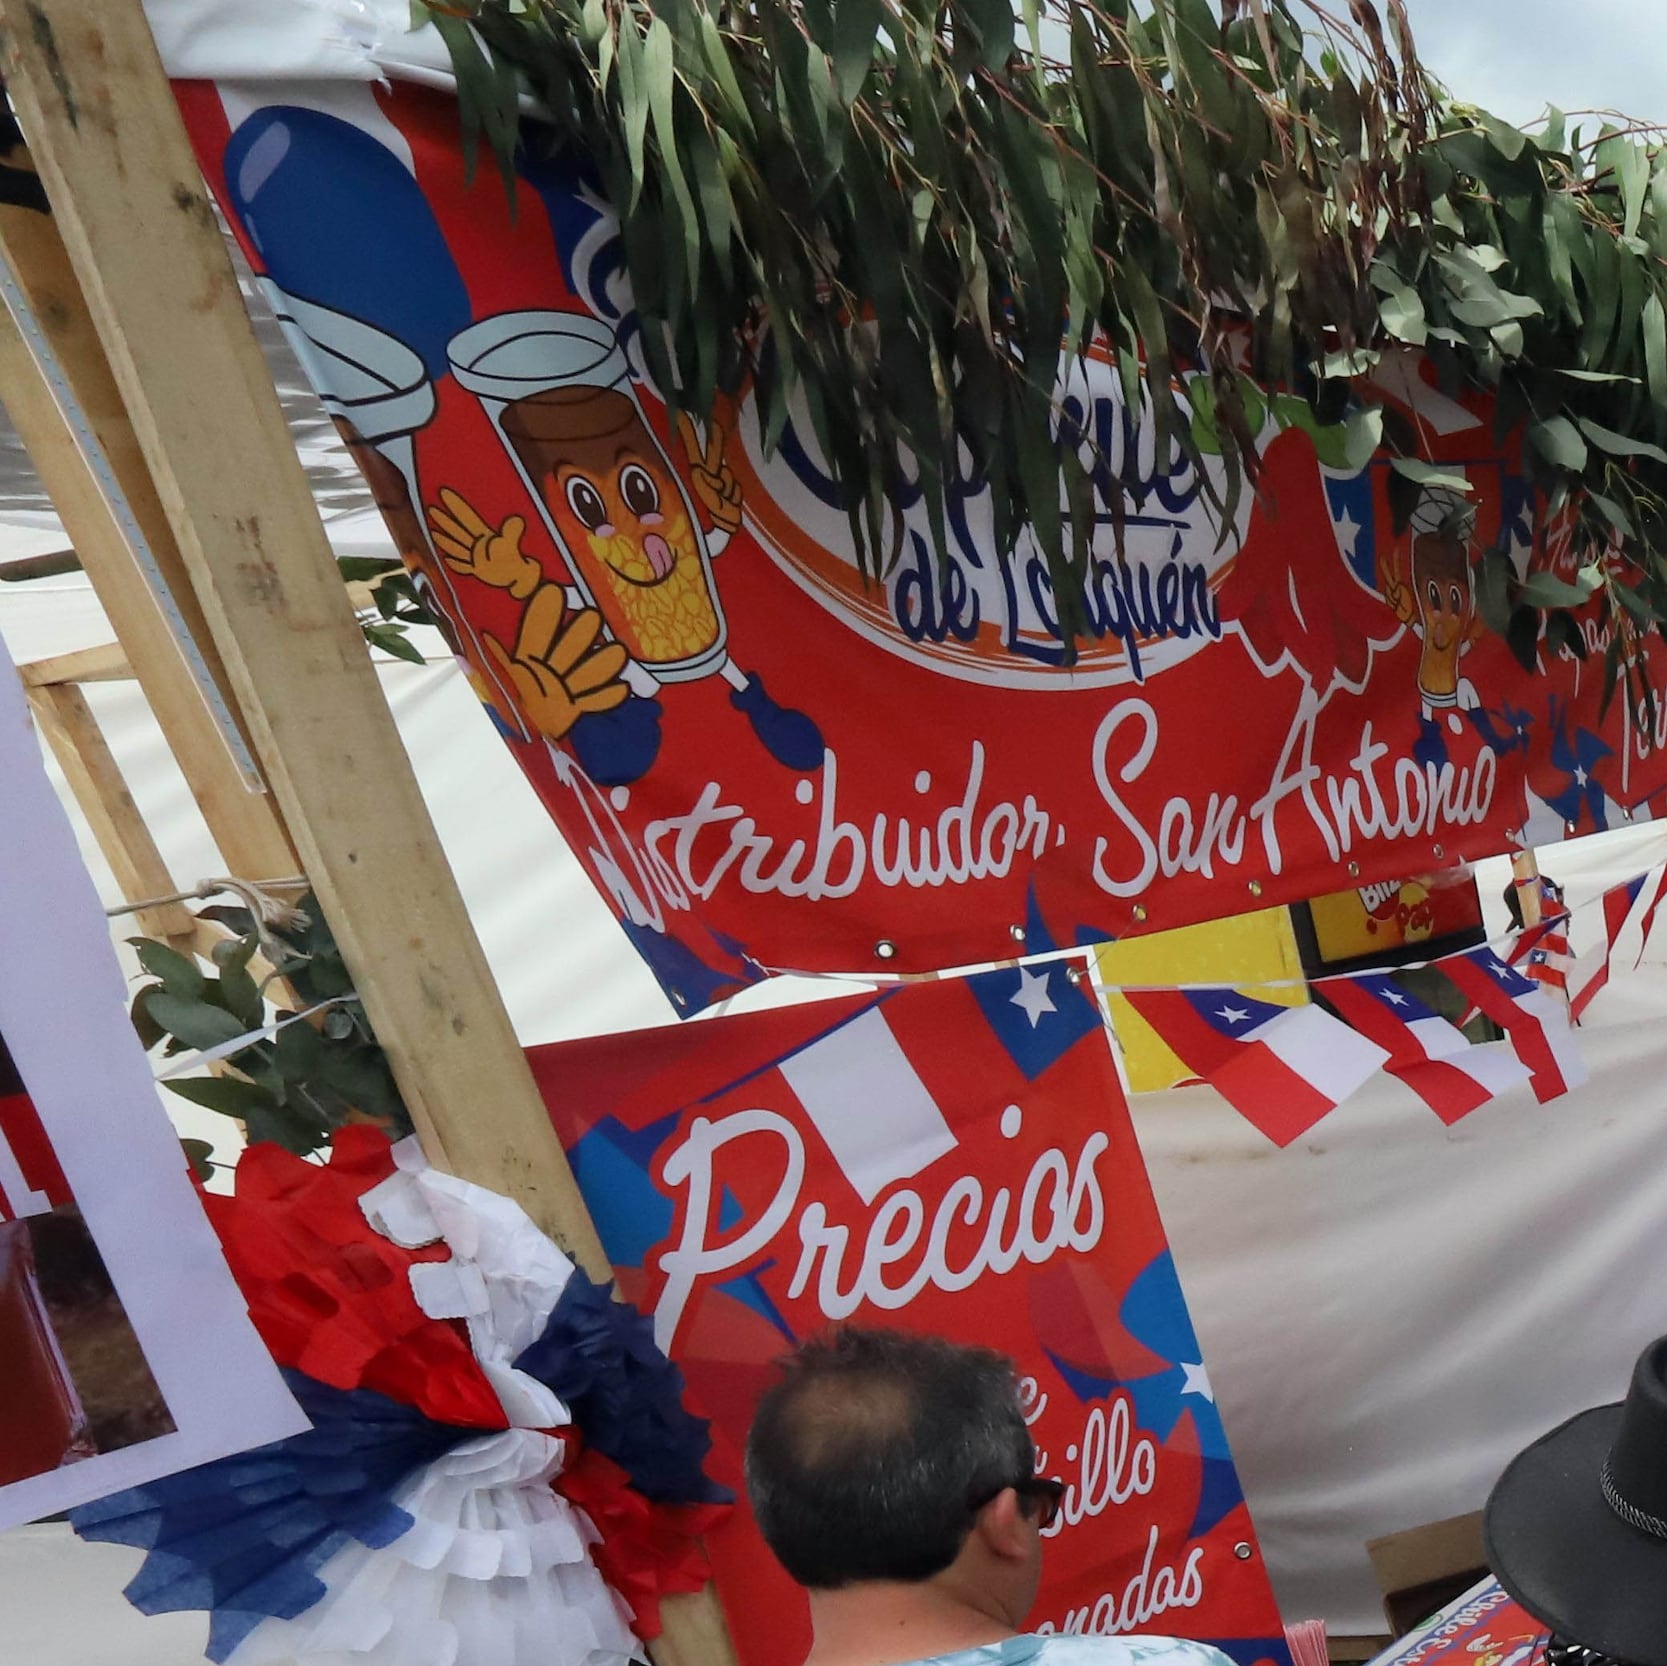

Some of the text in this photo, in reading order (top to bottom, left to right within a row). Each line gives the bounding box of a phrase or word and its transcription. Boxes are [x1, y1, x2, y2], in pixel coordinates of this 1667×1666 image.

[895, 528, 1223, 682] de Loquén
[543, 688, 1497, 933] Distribuidor San Antonio
[653, 1104, 1108, 1357] Precios
